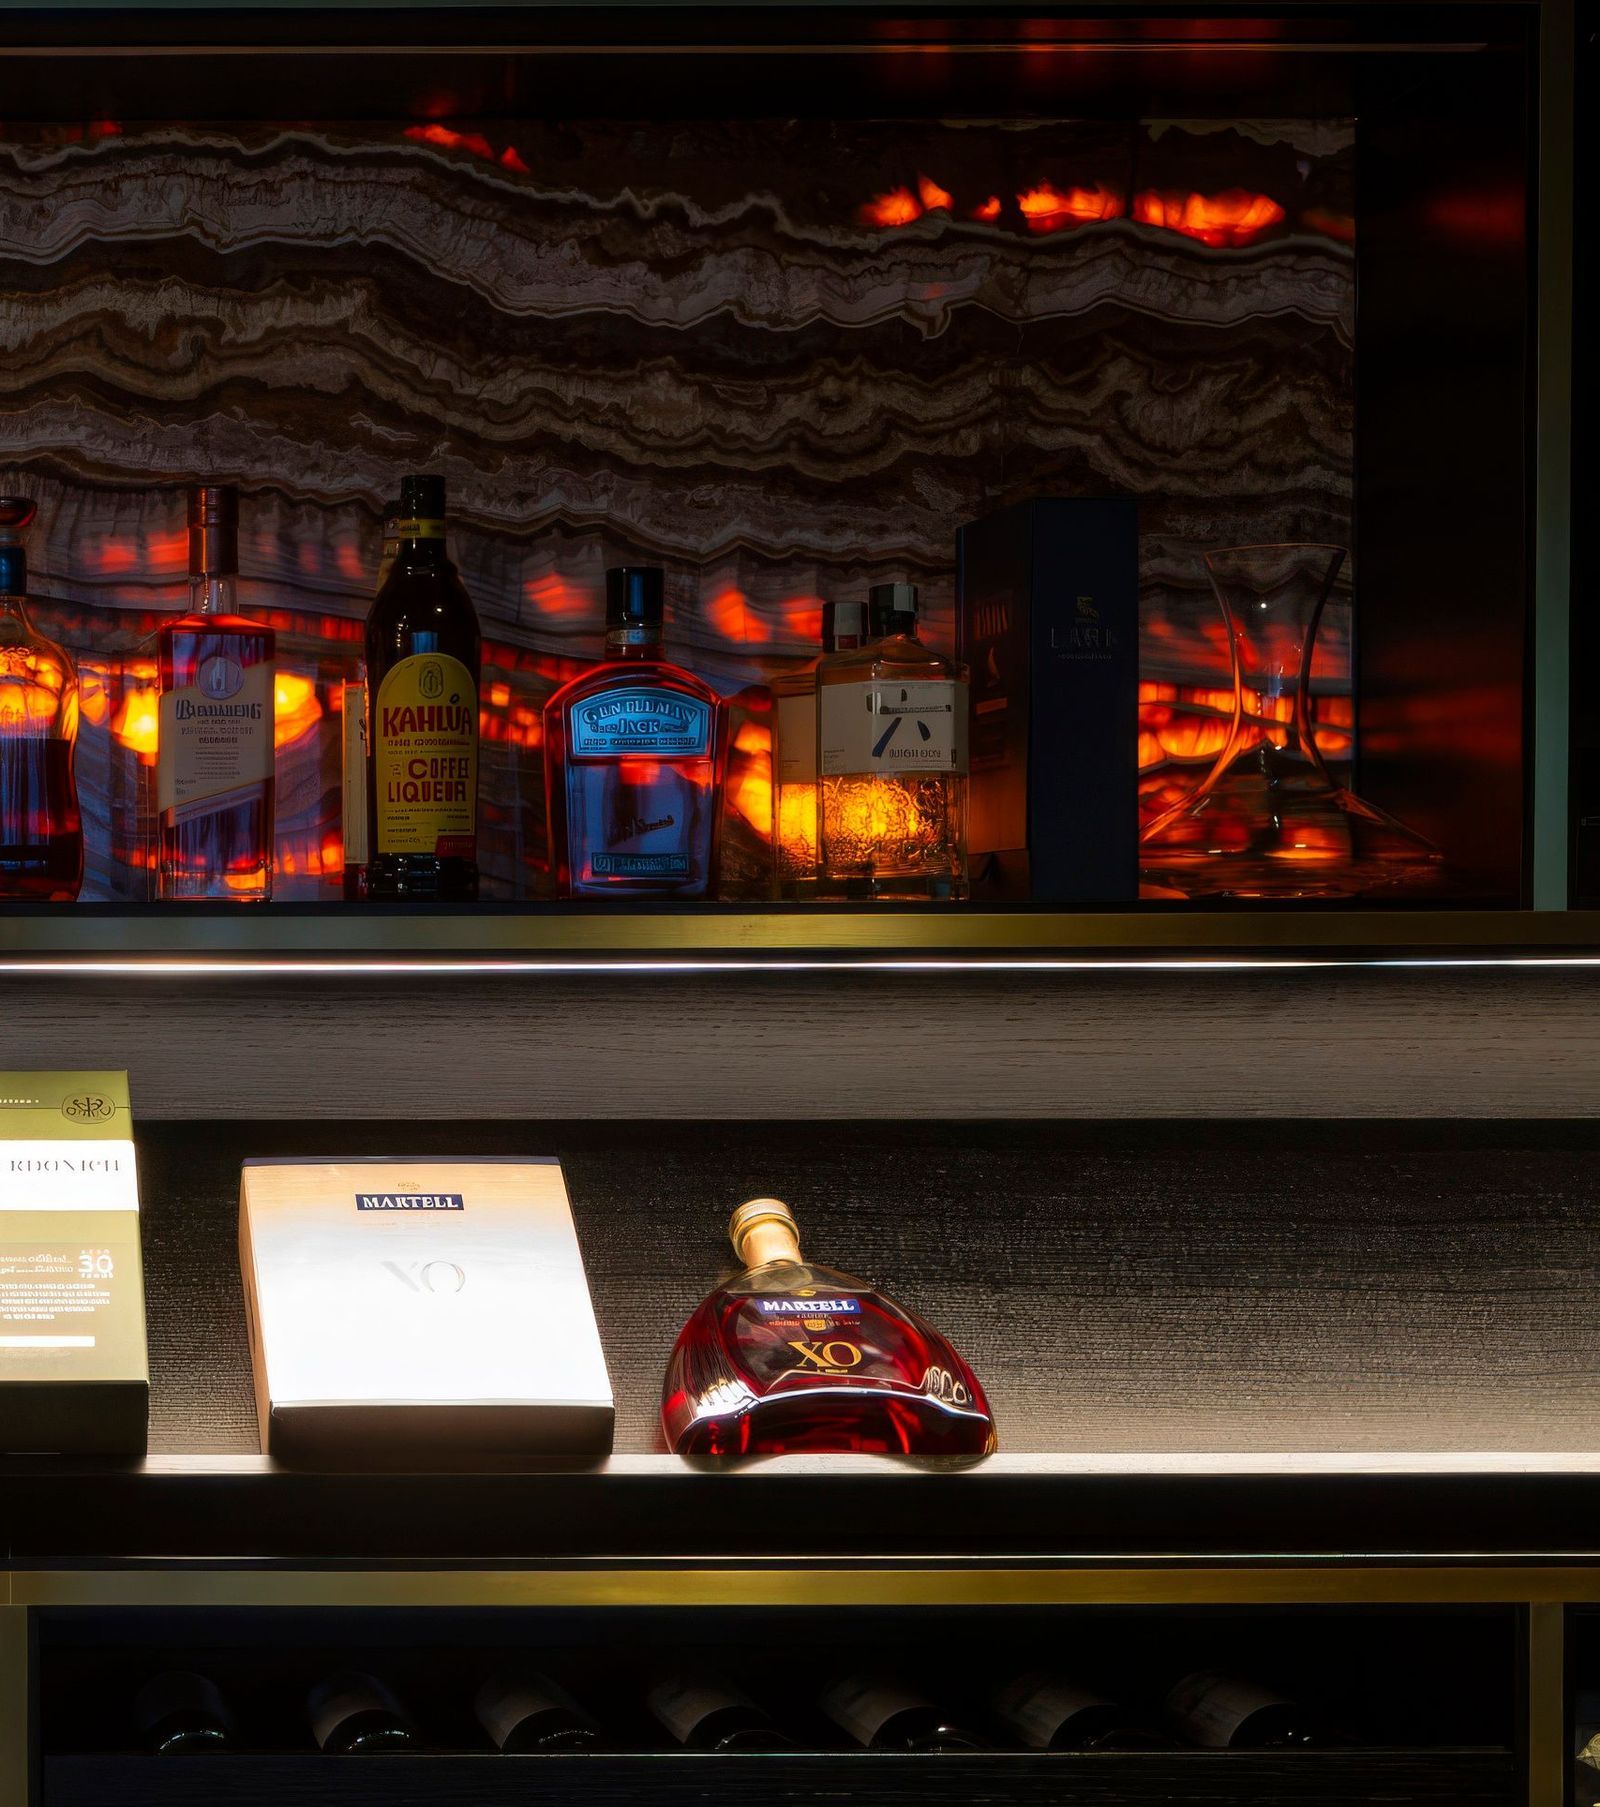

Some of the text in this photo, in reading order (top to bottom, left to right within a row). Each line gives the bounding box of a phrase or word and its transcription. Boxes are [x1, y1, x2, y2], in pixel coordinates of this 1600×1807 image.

[620, 719, 660, 733] JACK
[363, 1196, 458, 1208] MARTELL
[79, 1254, 113, 1274] 30
[763, 1300, 854, 1311] MARTELL
[788, 1341, 862, 1367] XO
